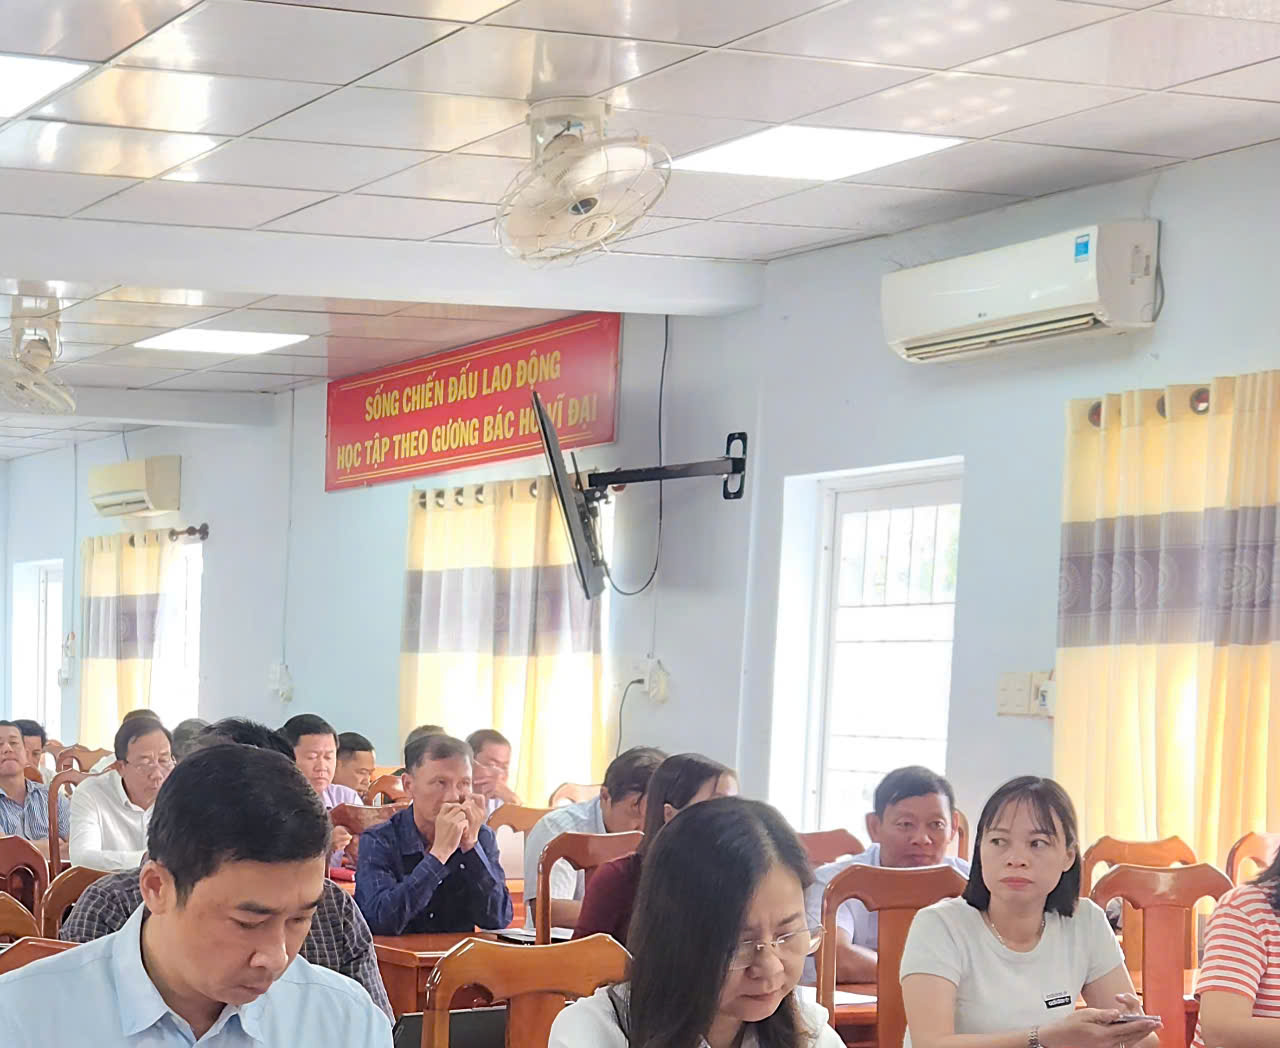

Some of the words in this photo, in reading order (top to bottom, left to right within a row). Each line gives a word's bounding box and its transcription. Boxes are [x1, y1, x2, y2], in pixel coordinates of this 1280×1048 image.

[364, 382, 400, 422] SỐNG
[402, 371, 444, 413] CHIẾN
[447, 361, 478, 404] ĐẤU
[482, 362, 512, 395] LAO
[516, 349, 561, 390] ĐỘNG
[336, 445, 362, 475] HỌC
[364, 432, 390, 469] TẬP
[392, 426, 428, 460] THEO
[431, 415, 480, 453] GƯƠNG
[483, 403, 515, 443] BÁC
[568, 392, 598, 431] ĐẠI
